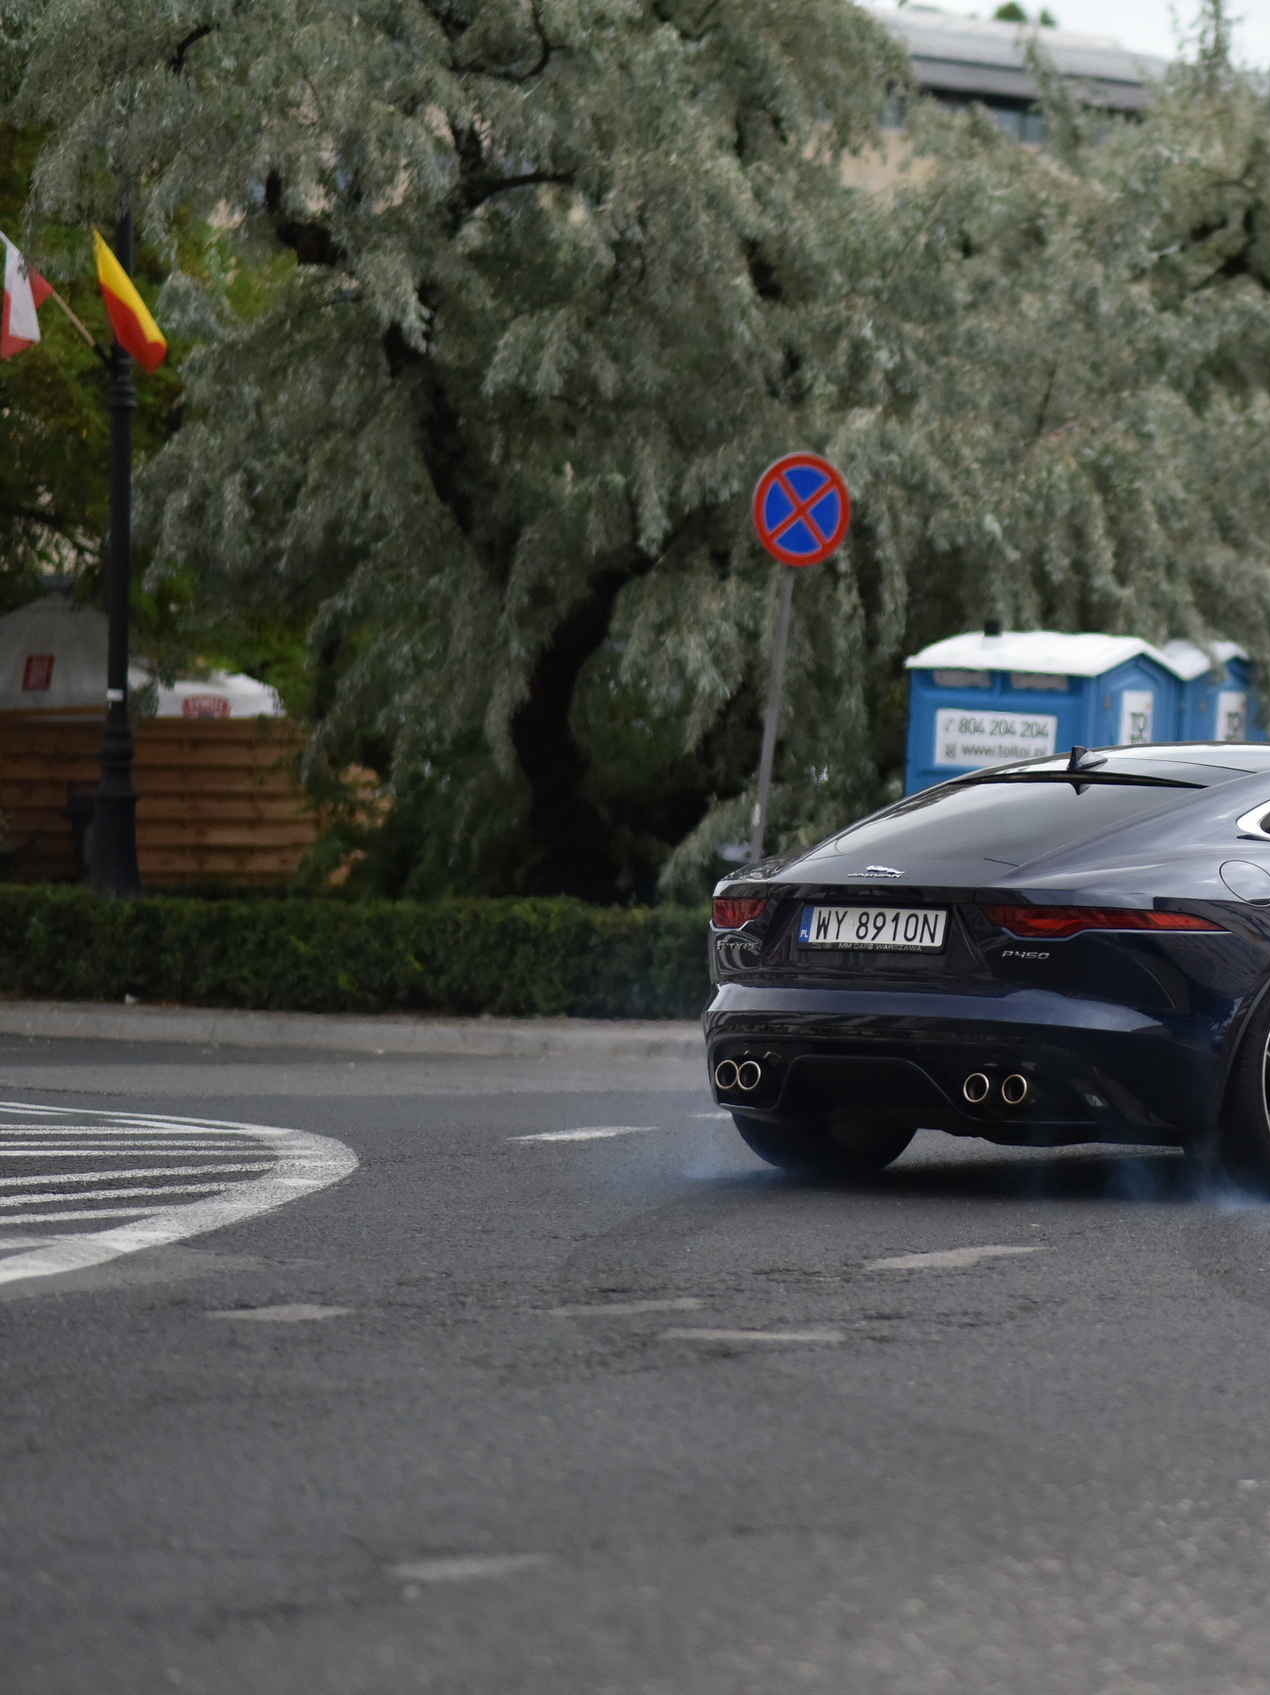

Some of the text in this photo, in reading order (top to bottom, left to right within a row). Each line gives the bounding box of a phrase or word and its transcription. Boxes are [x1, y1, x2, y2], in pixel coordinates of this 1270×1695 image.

[990, 719, 1016, 736] 204
[1020, 721, 1049, 738] 204
[800, 929, 808, 938] PL
[816, 910, 939, 943] WY 8910N
[1002, 950, 1050, 960] P450
